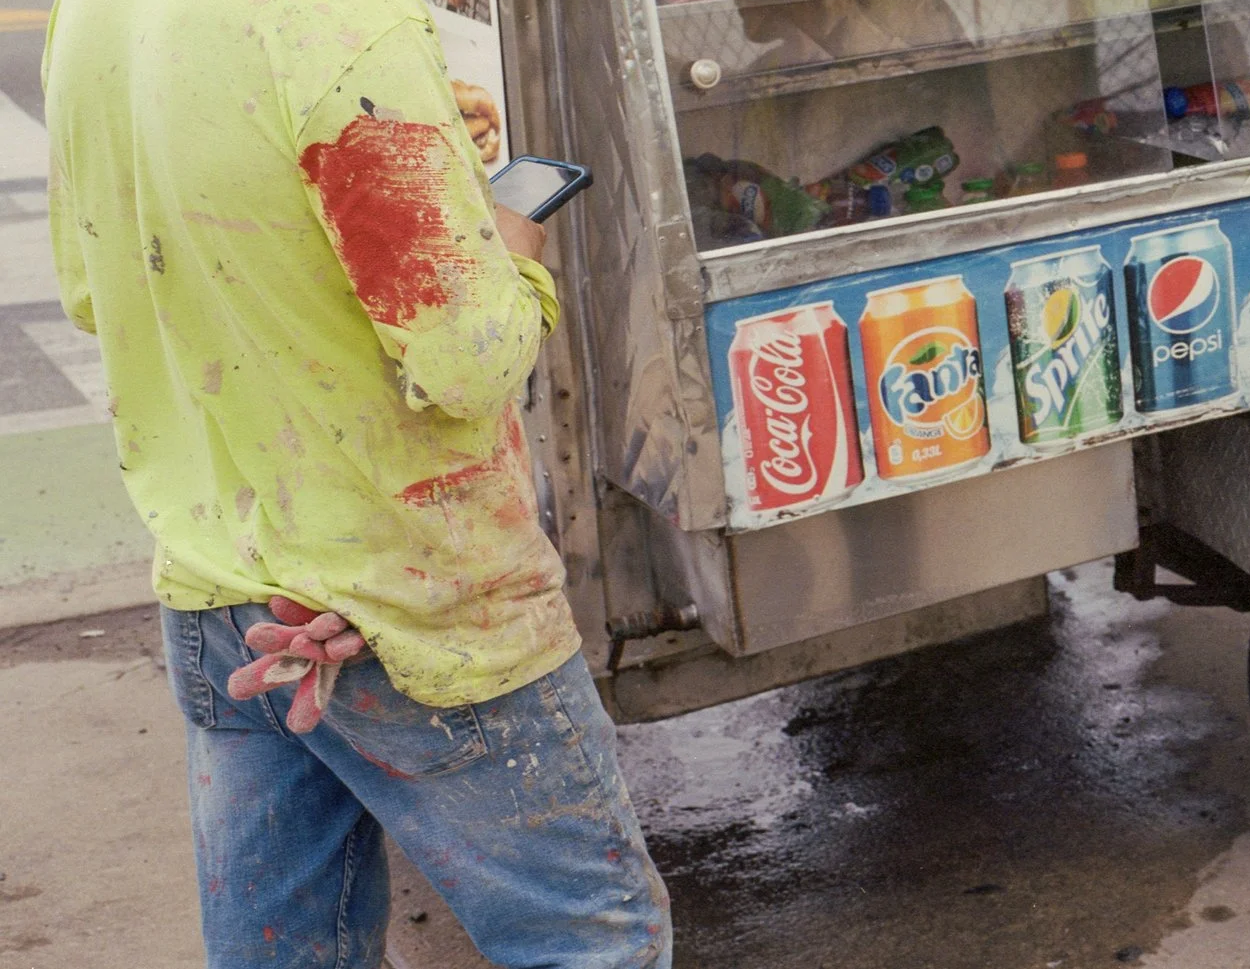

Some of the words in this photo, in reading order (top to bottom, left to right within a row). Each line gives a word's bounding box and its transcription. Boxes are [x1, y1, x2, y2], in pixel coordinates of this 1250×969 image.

[879, 344, 981, 426] Fanta
[1024, 292, 1111, 426] Sprite
[1153, 329, 1223, 368] pepsi
[749, 328, 818, 495] Coca-Cola
